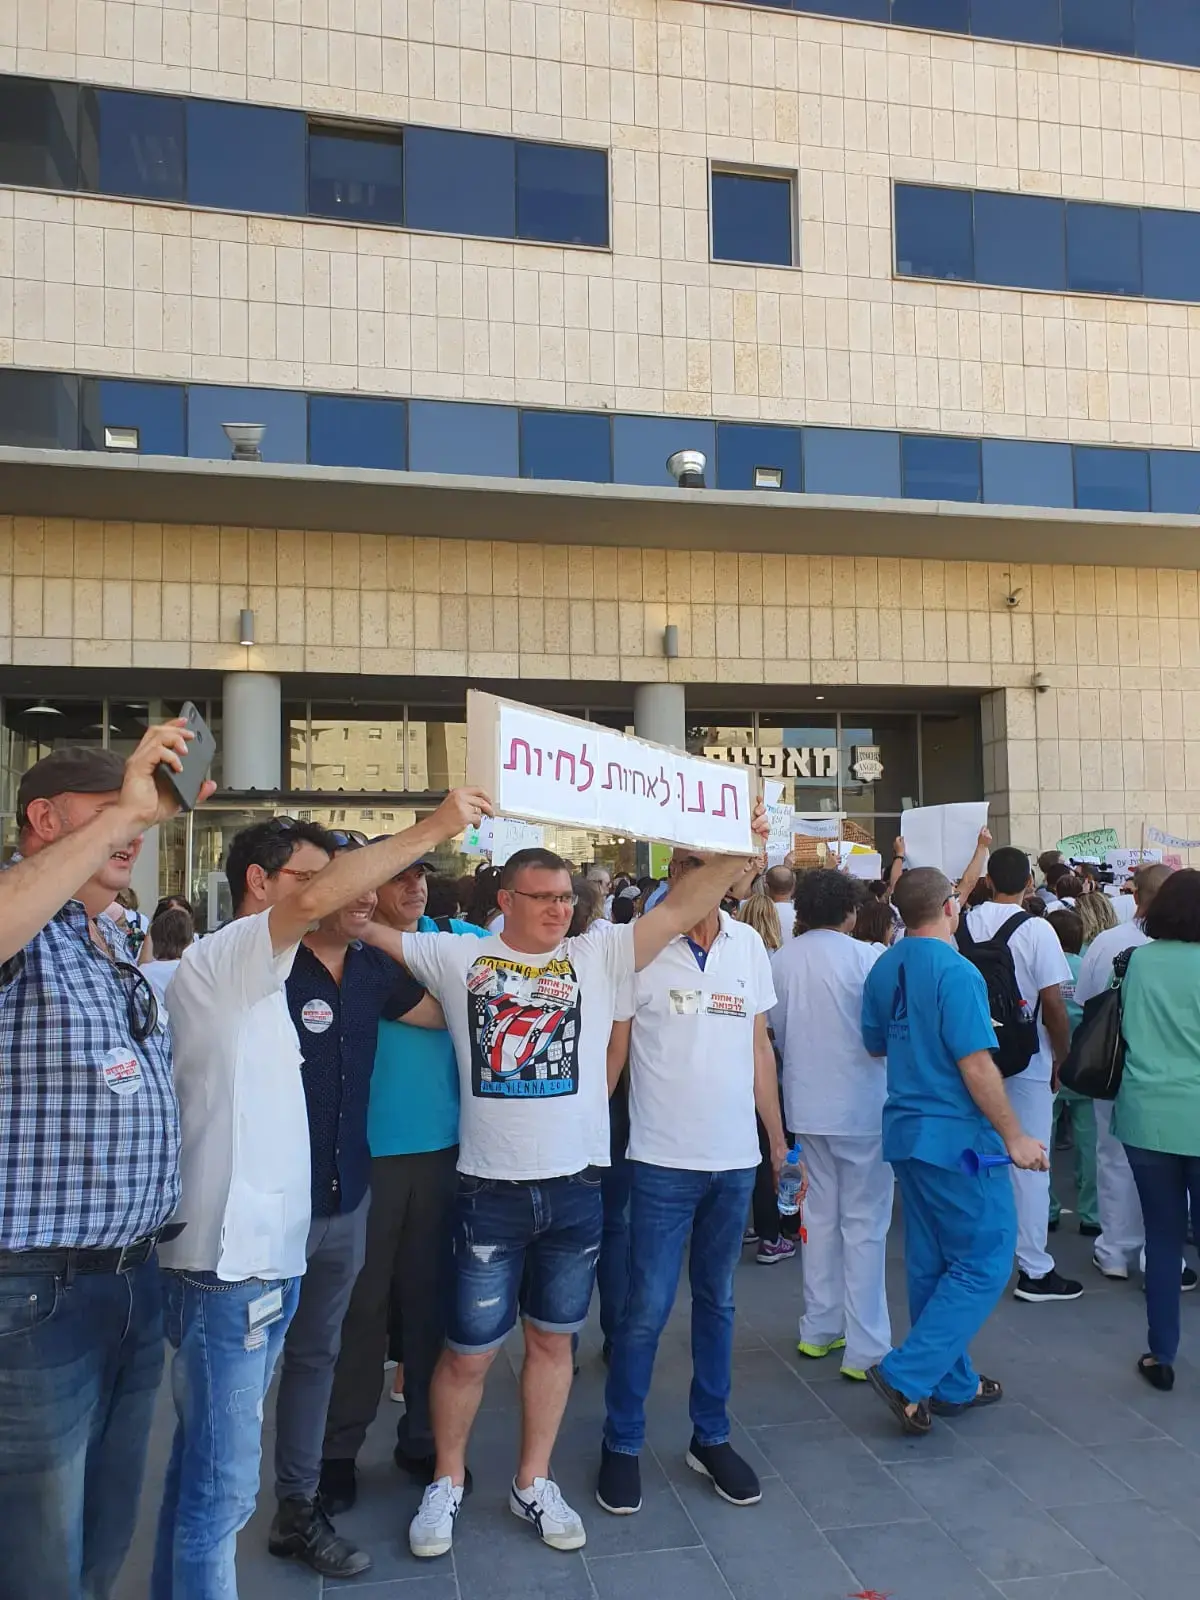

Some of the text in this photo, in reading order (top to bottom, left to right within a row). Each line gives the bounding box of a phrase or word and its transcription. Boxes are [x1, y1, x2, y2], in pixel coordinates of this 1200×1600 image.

[503, 738, 594, 792] לחיות
[601, 761, 671, 807] לאחיות
[506, 1081, 545, 1094] VIENNA
